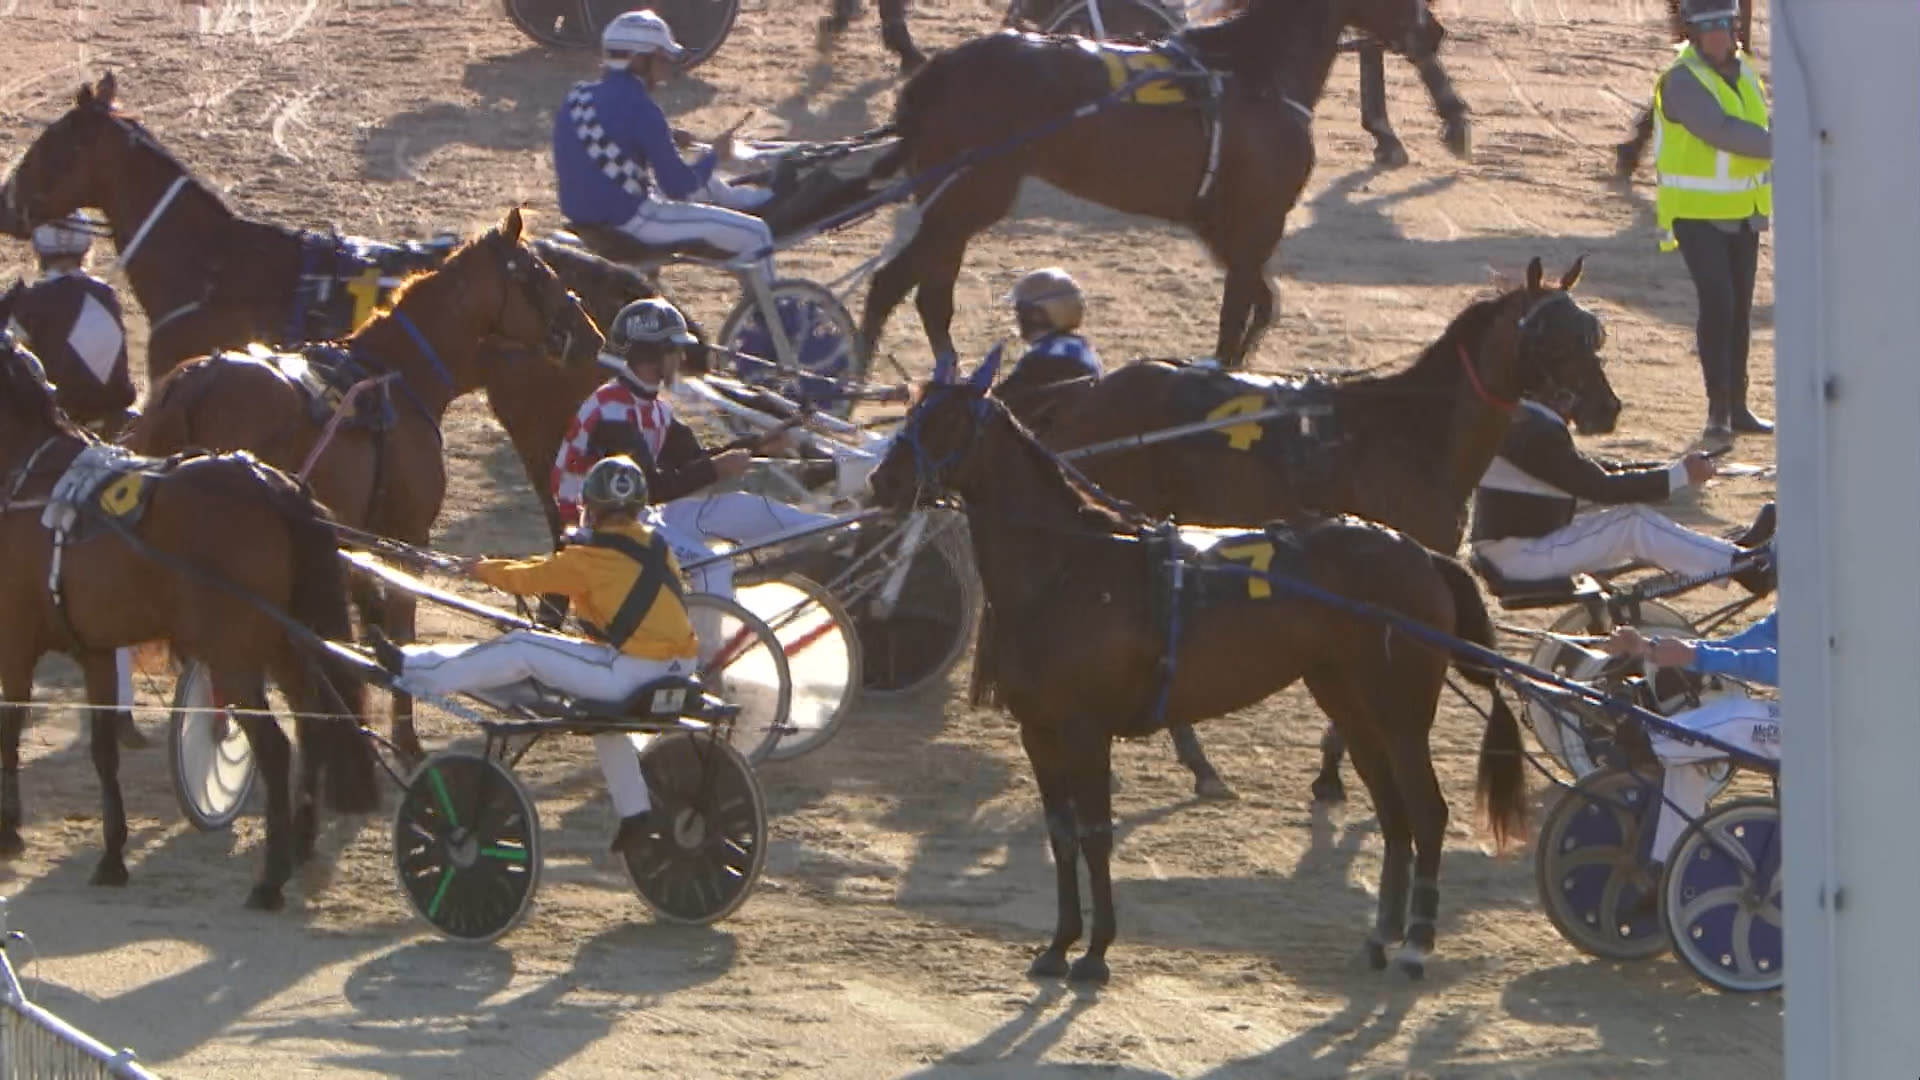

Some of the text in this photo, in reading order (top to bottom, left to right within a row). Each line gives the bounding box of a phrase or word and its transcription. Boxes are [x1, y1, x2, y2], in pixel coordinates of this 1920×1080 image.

[1102, 51, 1186, 105] 12
[1206, 394, 1266, 451] 4
[1217, 542, 1275, 600] 7
